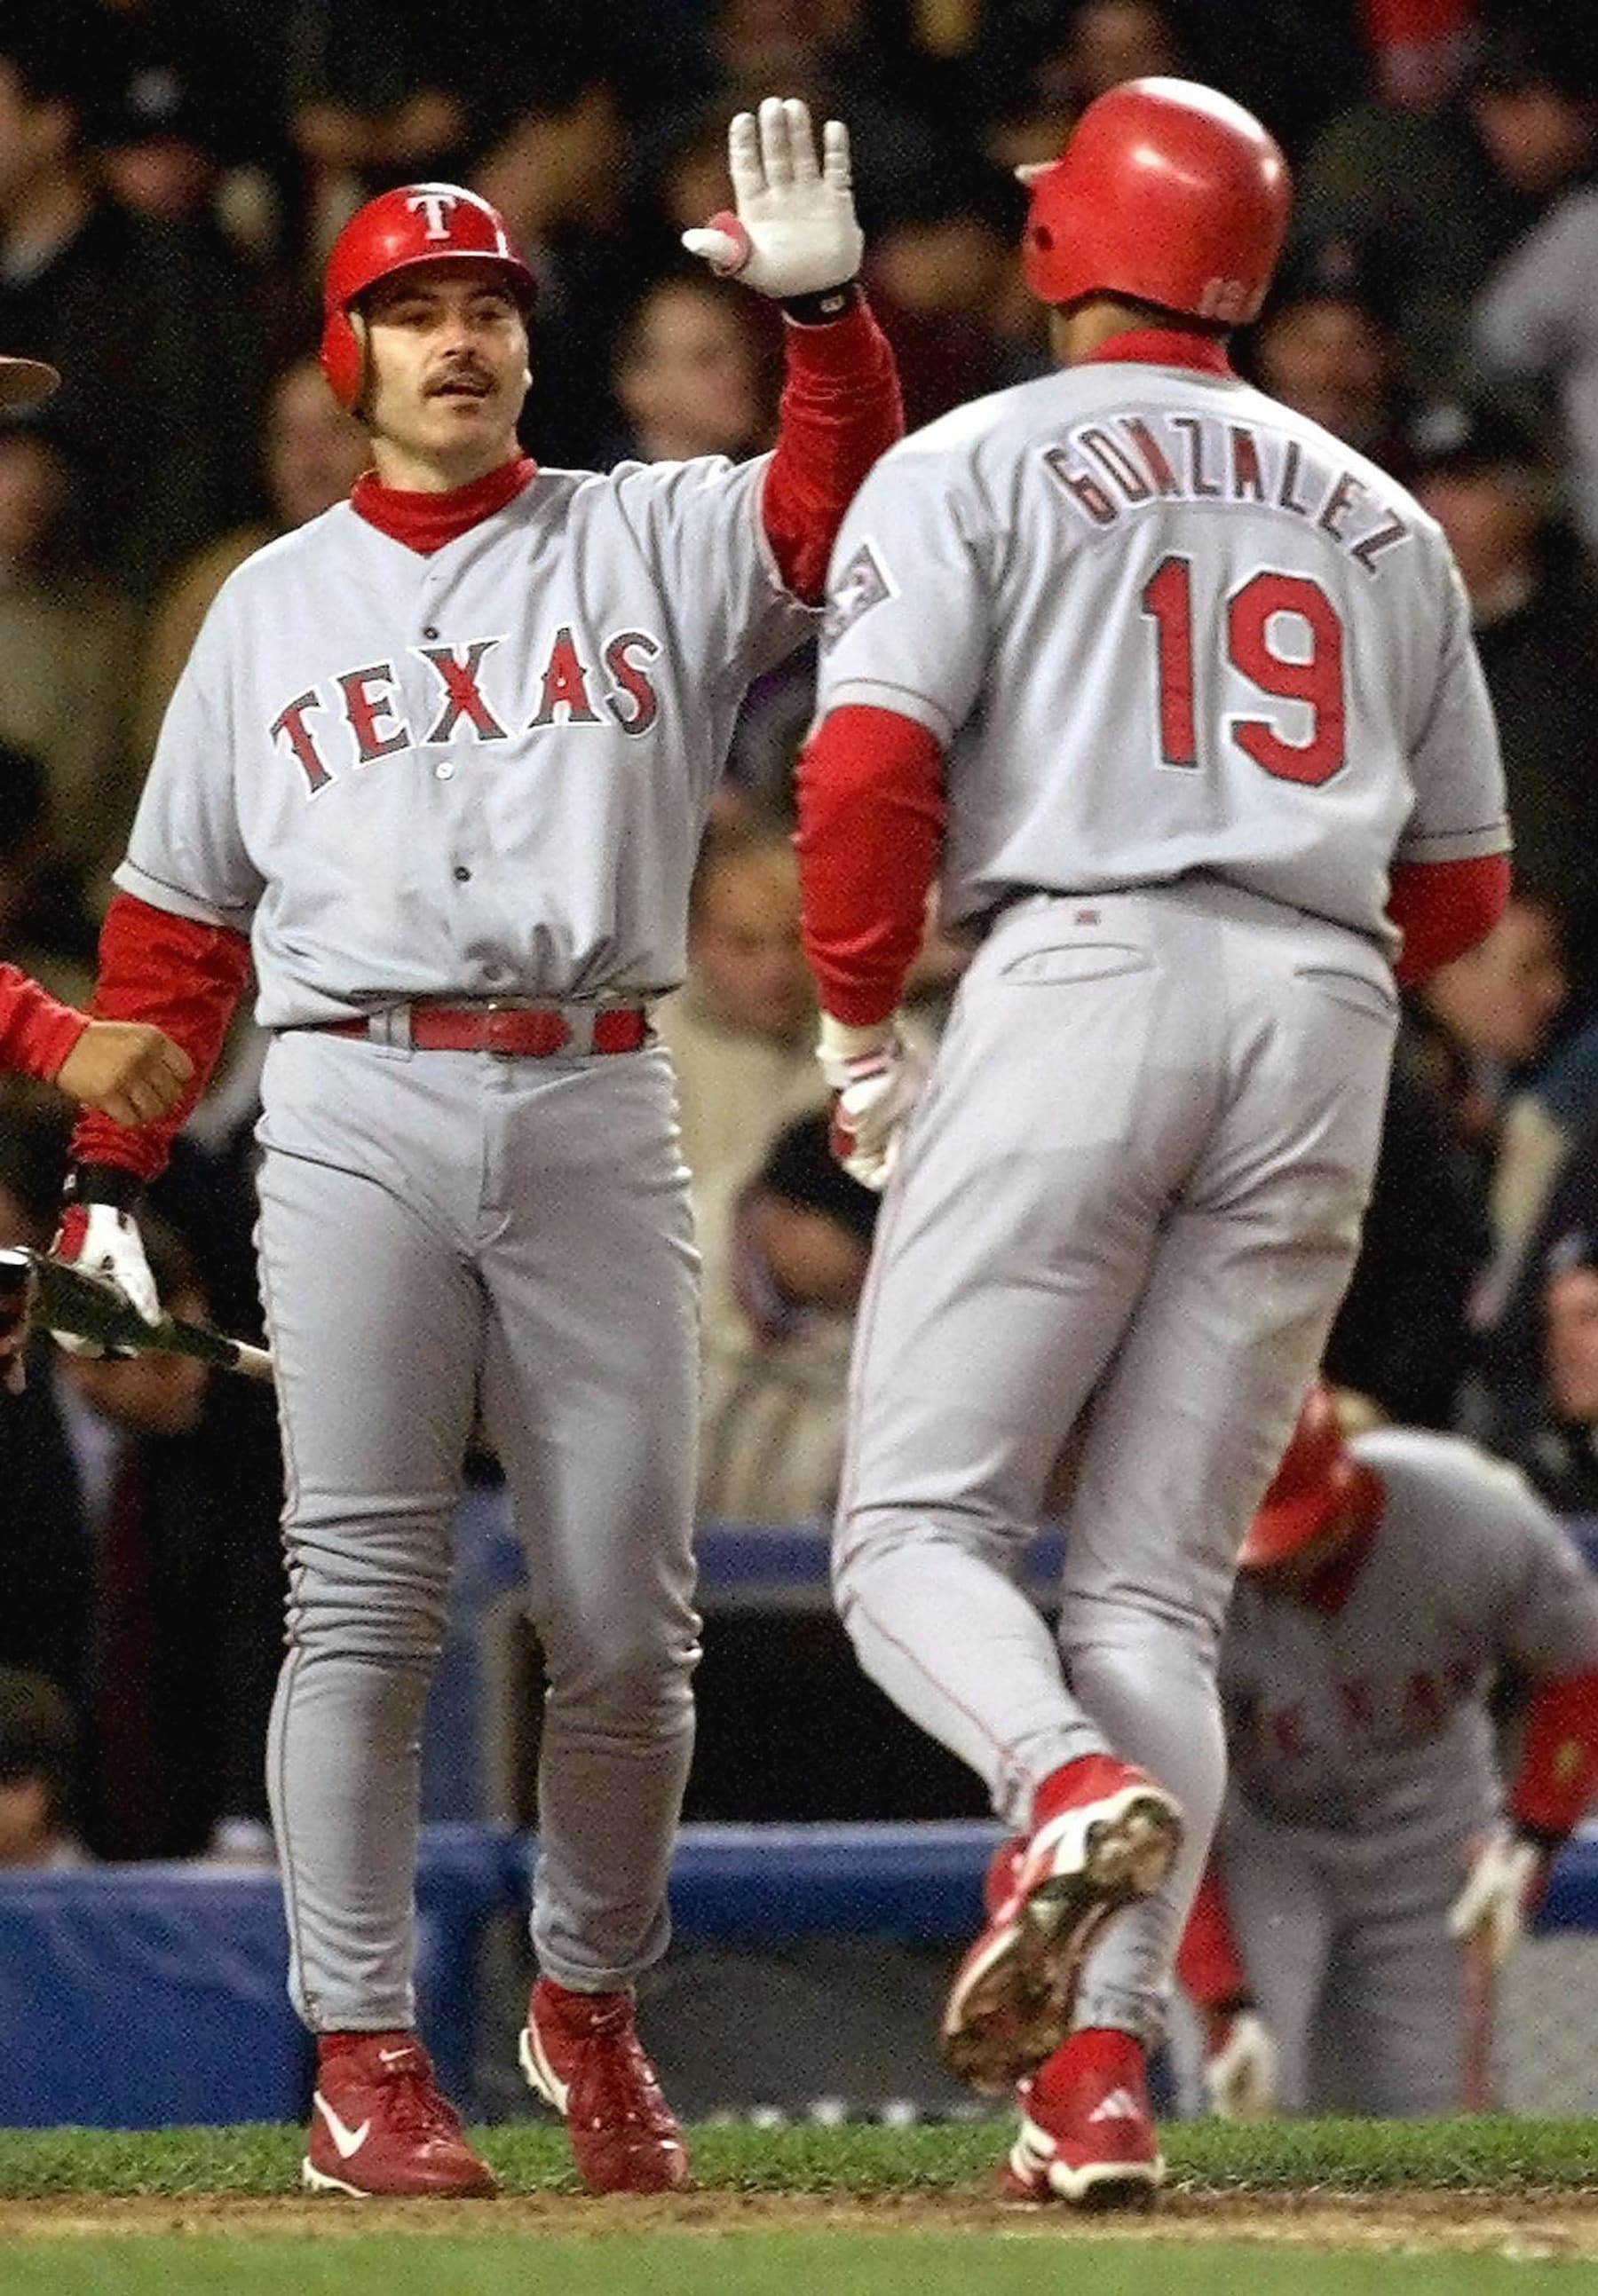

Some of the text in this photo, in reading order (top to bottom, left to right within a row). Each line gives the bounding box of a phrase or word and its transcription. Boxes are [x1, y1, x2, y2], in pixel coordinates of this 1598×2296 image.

[405, 193, 457, 241] T
[1040, 414, 1412, 577] GONZALEZ
[268, 621, 661, 801] TEXAS
[1141, 552, 1349, 789] 19
